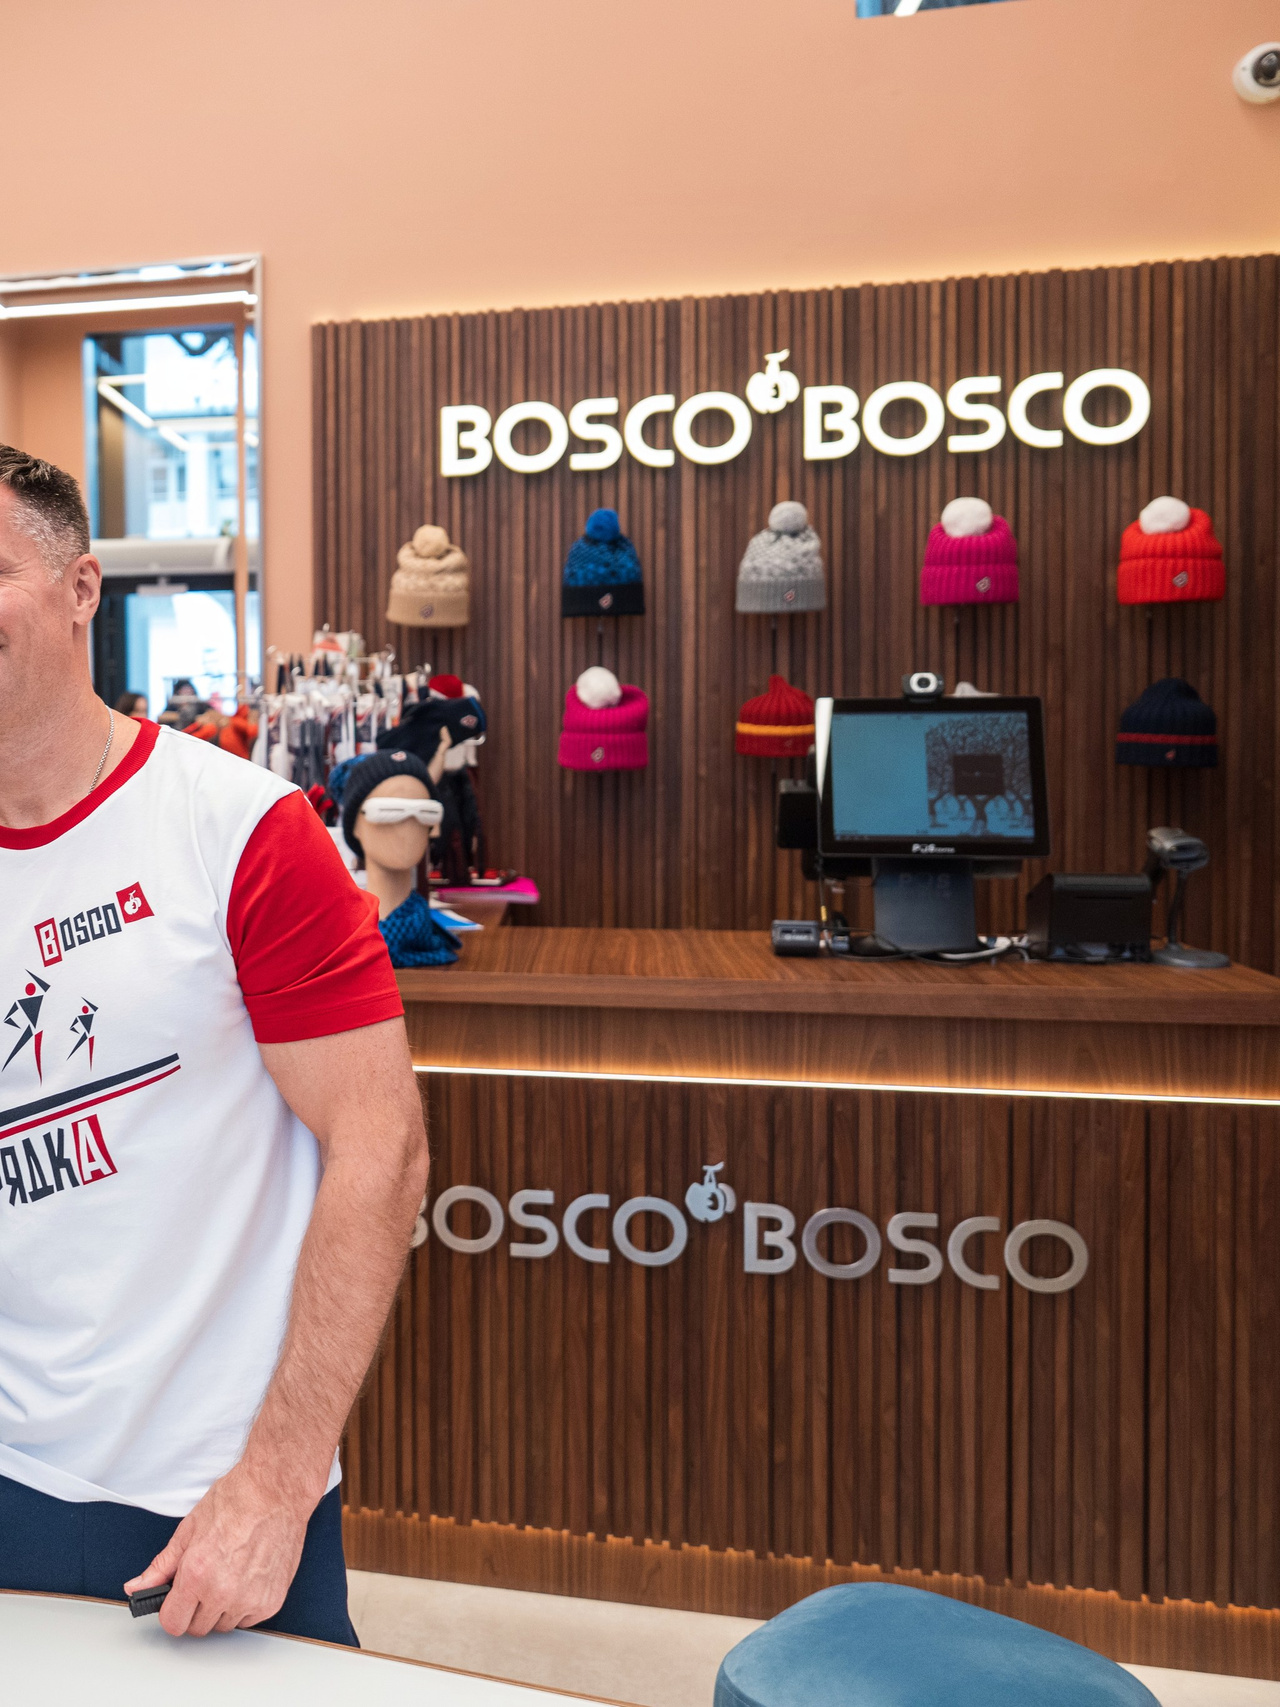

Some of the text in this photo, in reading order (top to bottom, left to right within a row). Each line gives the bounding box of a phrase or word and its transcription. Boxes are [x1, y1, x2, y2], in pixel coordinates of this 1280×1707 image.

[439, 368, 1152, 478] BOSCO BOSCO
[34, 902, 123, 968] BOSCO
[744, 1200, 1090, 1294] BOSCO
